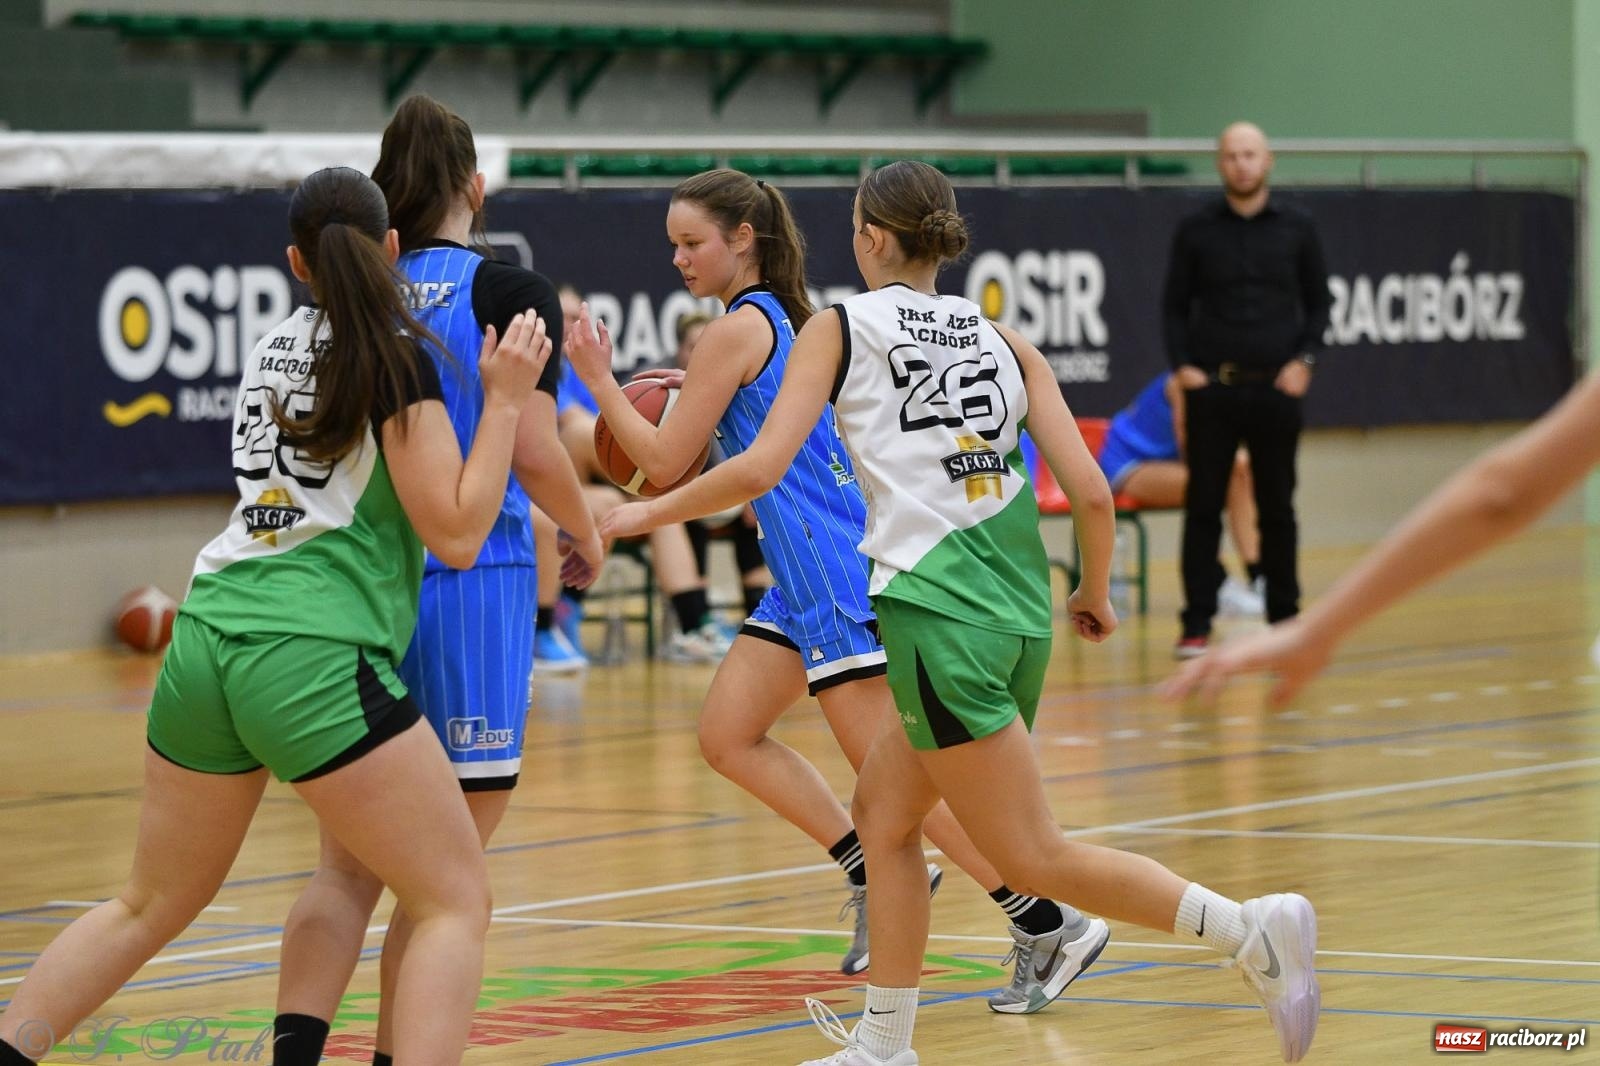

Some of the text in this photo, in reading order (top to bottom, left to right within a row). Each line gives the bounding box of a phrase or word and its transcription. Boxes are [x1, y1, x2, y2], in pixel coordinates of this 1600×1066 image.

[99, 264, 293, 383] OSiR
[946, 313, 979, 330] AZS
[964, 250, 1109, 347] OSiR
[888, 344, 1008, 440] 26
